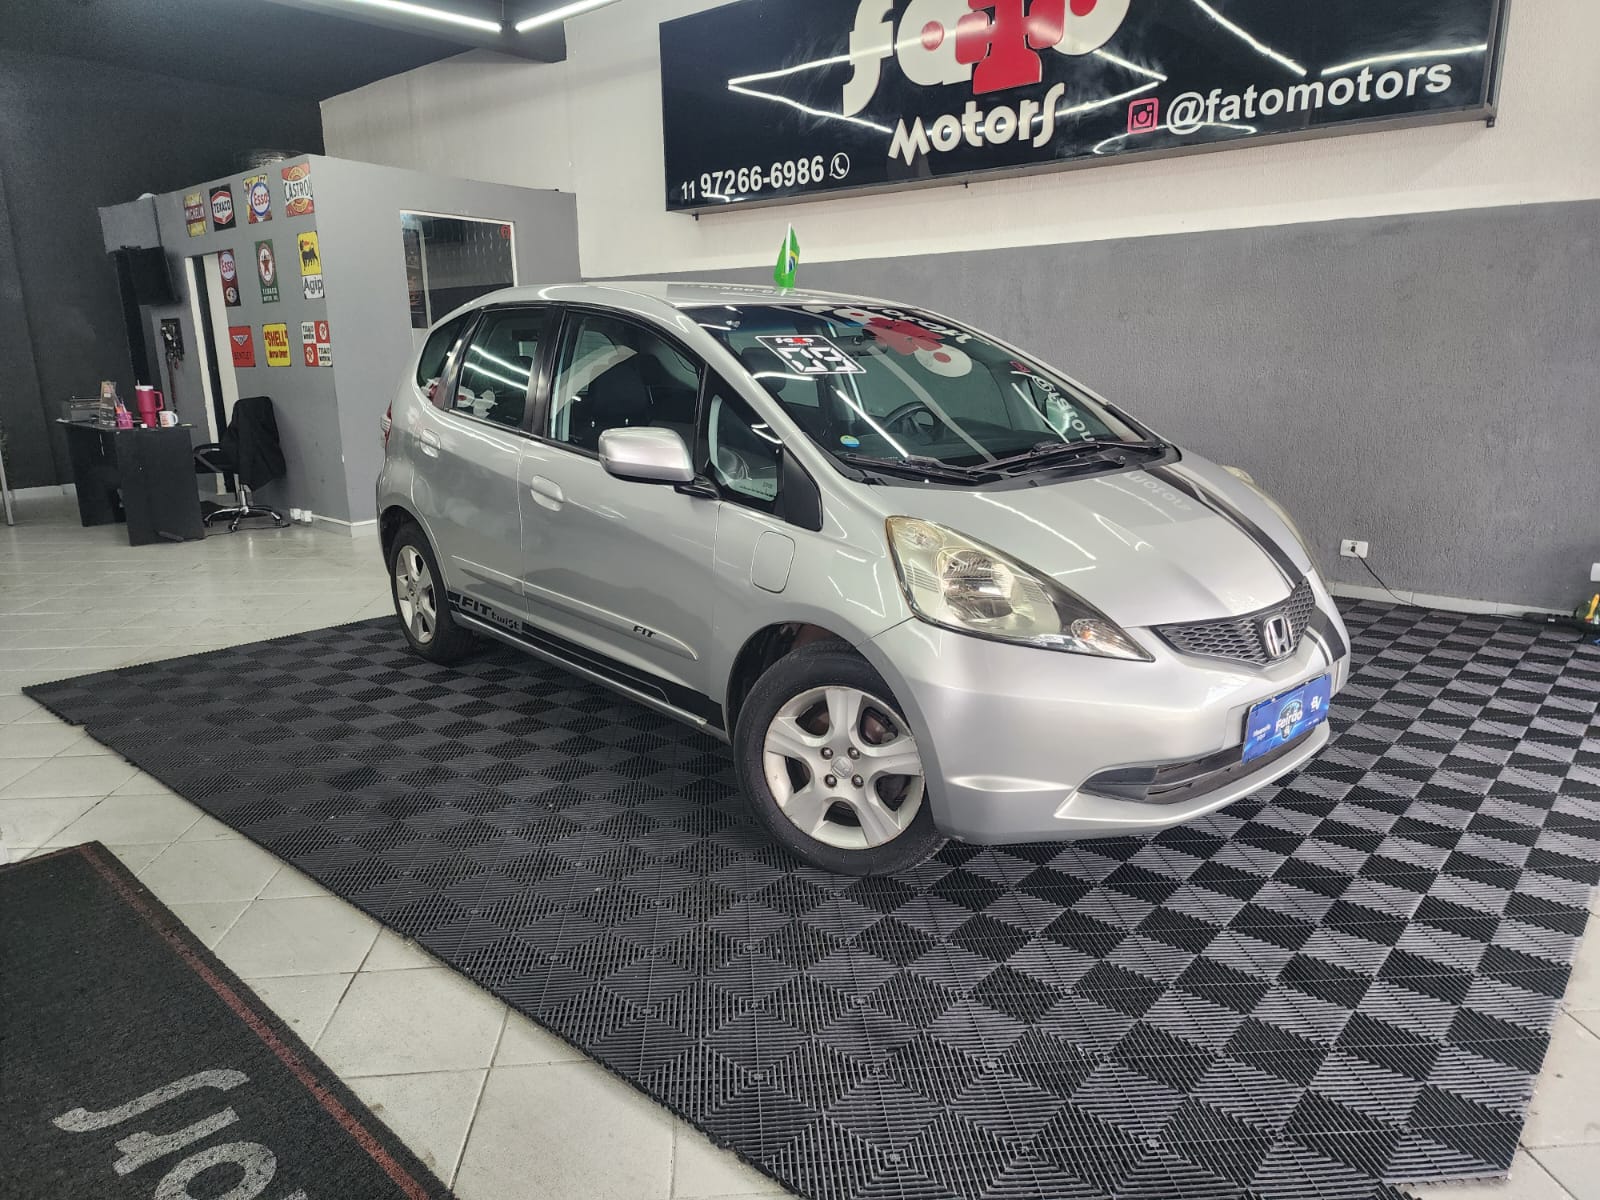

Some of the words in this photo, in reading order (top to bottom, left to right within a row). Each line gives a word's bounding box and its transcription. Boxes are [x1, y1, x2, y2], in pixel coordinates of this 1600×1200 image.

[1166, 63, 1453, 135] @fatomotors
[680, 180, 696, 200] 11
[700, 154, 825, 198] 97266-6986
[213, 203, 231, 213] TEXACO
[303, 277, 323, 294] Agip
[461, 595, 492, 616] FIT
[632, 625, 657, 639] FIT
